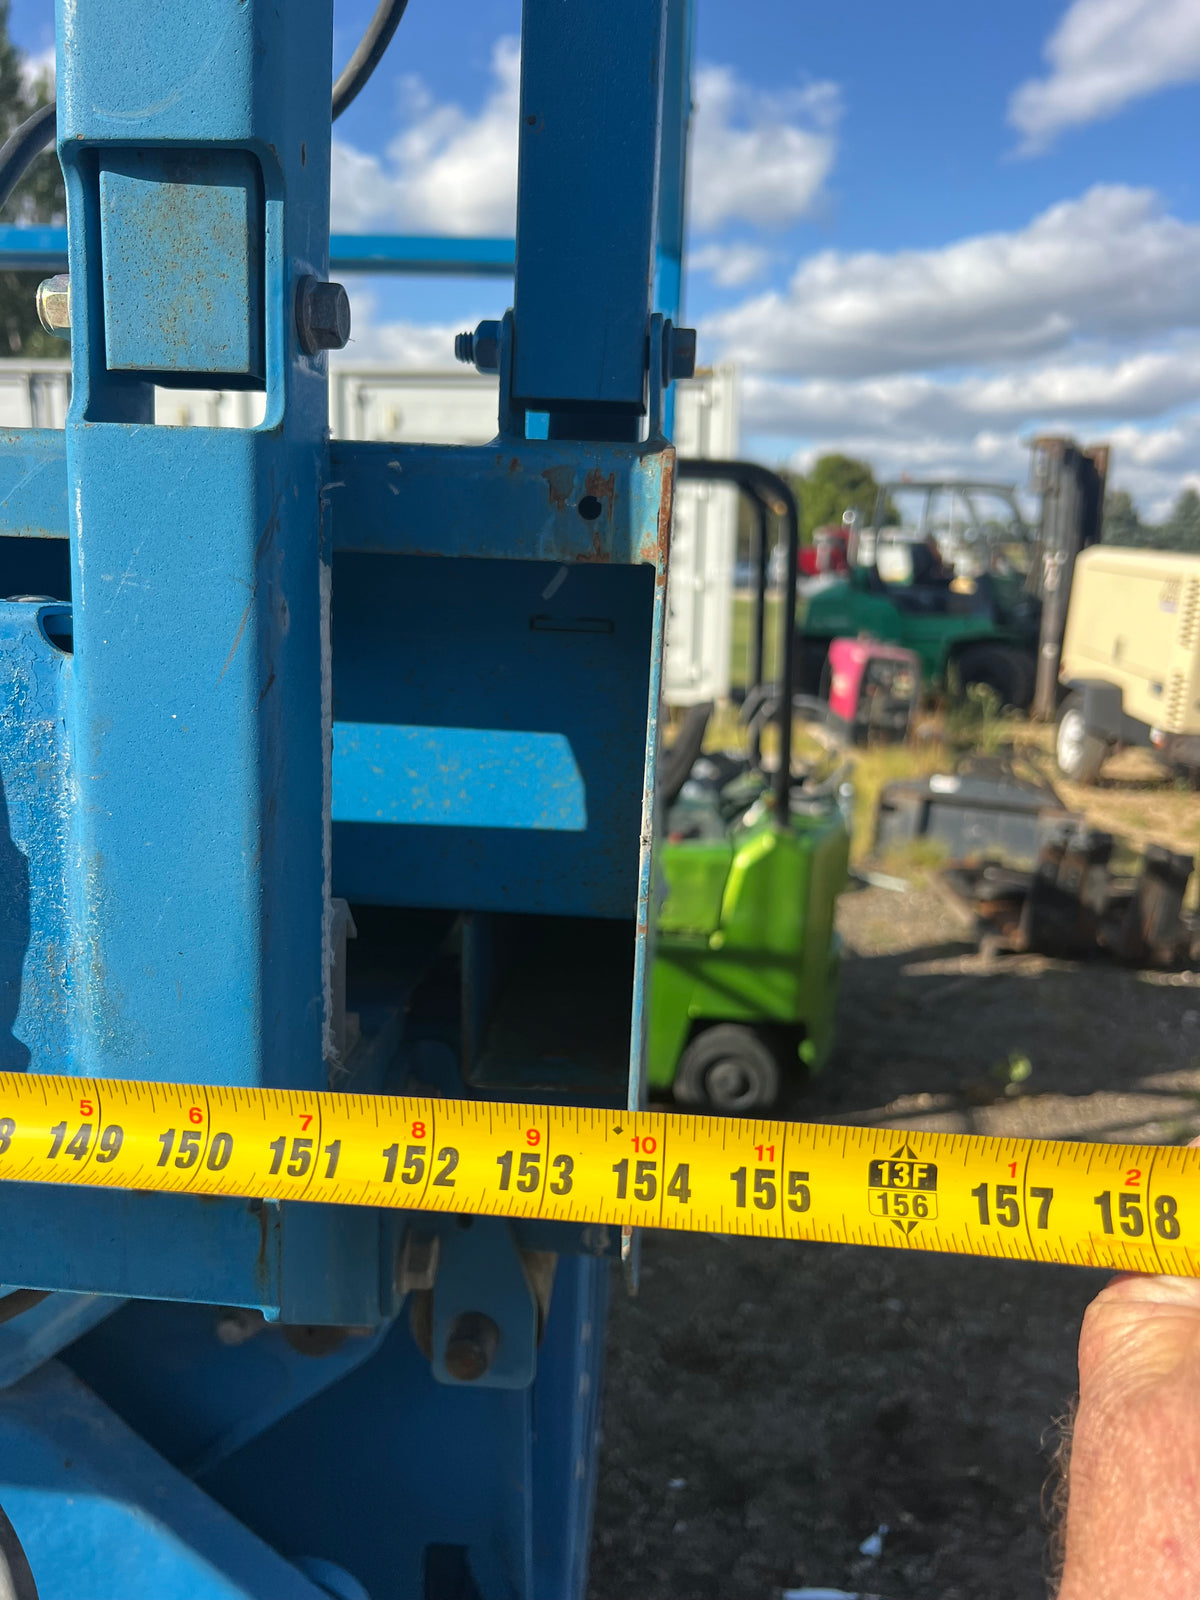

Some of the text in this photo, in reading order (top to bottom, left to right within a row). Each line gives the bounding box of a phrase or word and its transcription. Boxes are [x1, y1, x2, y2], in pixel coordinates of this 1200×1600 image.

[47, 1121, 124, 1163] 149
[157, 1128, 232, 1171] 150
[269, 1136, 341, 1179] 151
[382, 1143, 459, 1187] 152
[496, 1151, 574, 1195] 153
[612, 1159, 691, 1204] 154
[730, 1166, 810, 1212] 155
[876, 1192, 928, 1218] 156
[971, 1183, 1053, 1229] 157
[1094, 1190, 1181, 1239] 158
[79, 1100, 1140, 1186] 5 6 7 8 9 10 11 1 2
[877, 1161, 928, 1188] 13F
